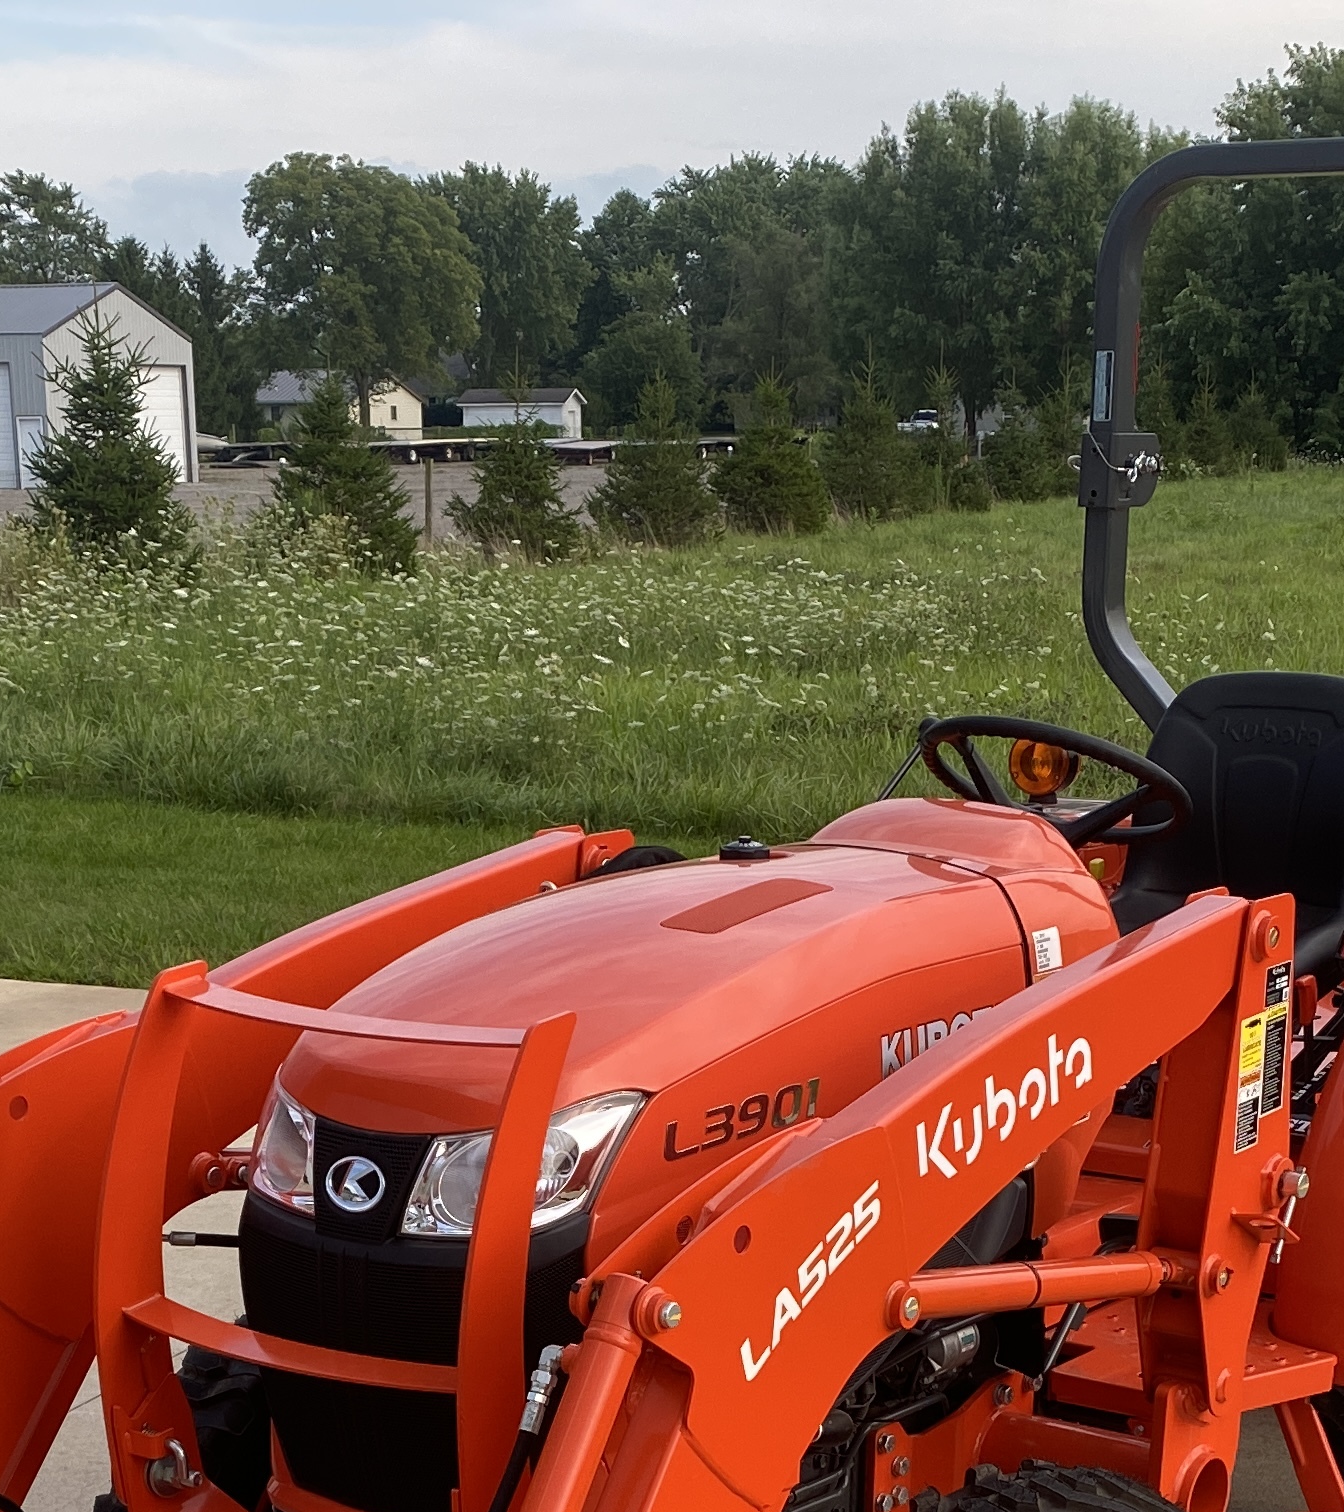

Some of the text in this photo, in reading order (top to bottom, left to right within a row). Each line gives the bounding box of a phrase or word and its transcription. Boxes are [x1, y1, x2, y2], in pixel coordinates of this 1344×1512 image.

[1220, 715, 1323, 749] Kubota
[663, 1076, 821, 1162] L3901
[916, 1033, 1093, 1179] Kubota
[740, 1179, 881, 1382] LA525
